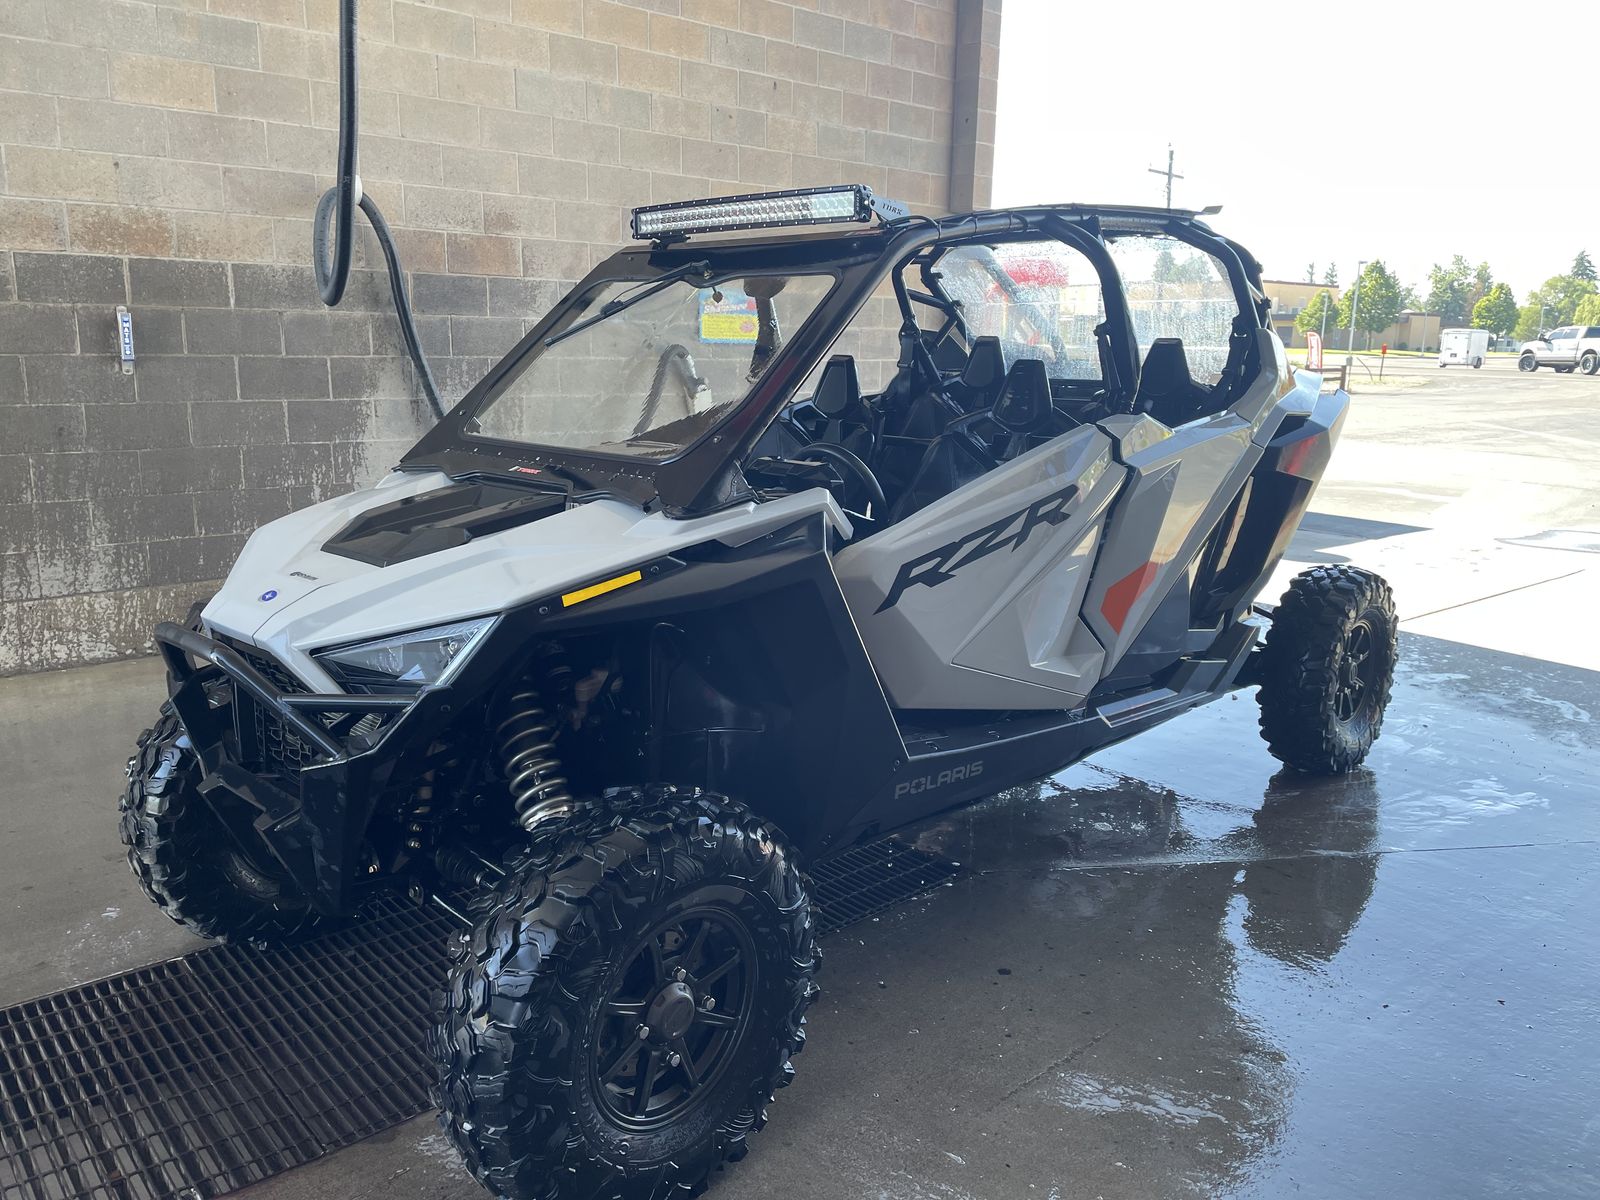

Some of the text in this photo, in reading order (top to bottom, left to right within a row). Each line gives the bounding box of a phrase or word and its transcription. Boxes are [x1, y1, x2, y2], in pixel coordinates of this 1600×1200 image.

[122, 321, 130, 344] MATS
[873, 484, 1079, 615] RZR
[895, 760, 984, 800] POLARIS
